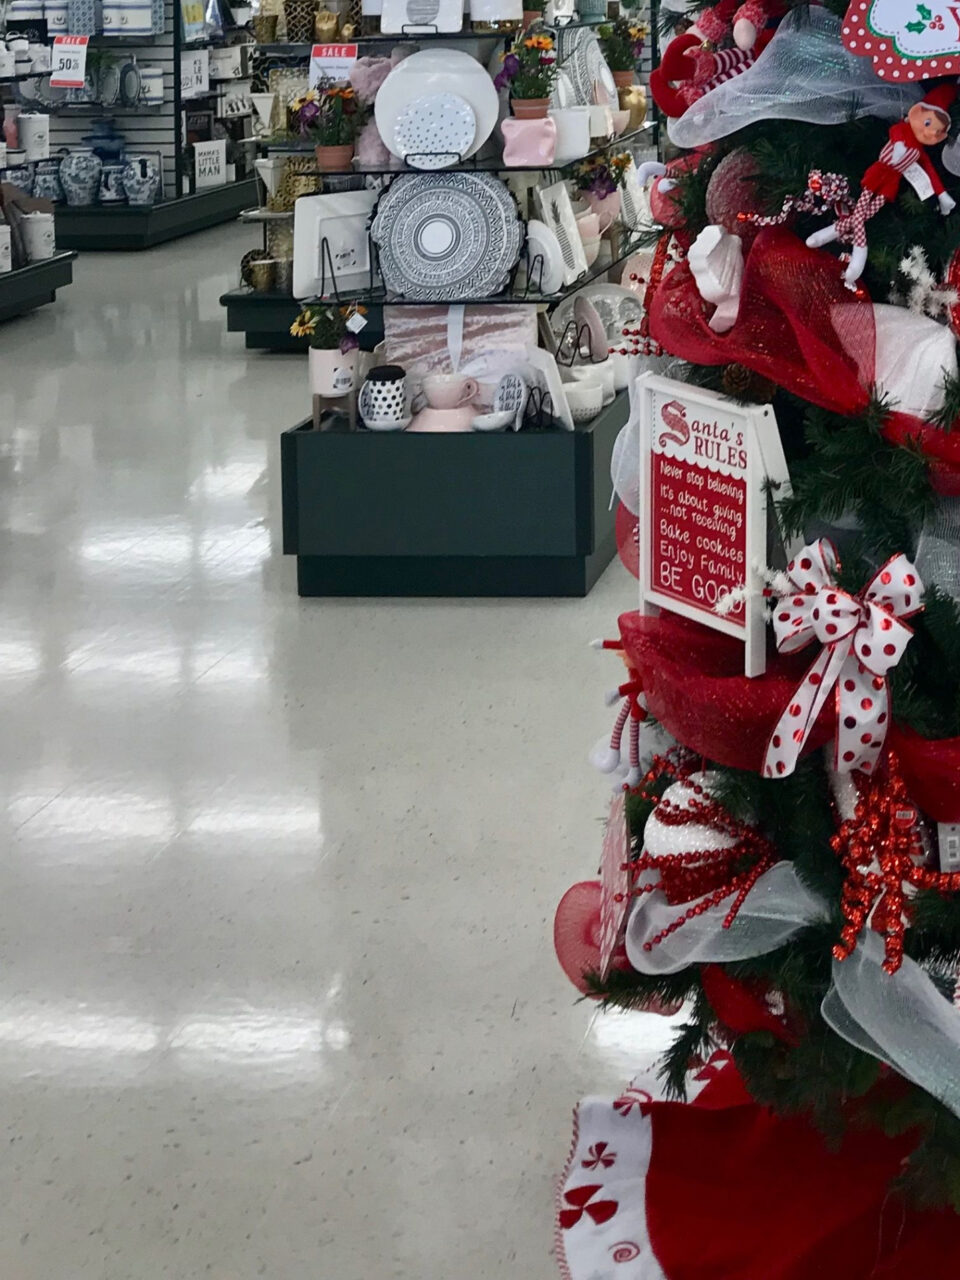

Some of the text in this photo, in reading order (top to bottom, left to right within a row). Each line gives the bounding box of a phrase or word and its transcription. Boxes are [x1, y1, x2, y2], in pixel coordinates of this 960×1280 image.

[321, 46, 348, 57] SALE
[198, 156, 220, 167] LITTLE
[198, 165, 220, 177] MAN
[658, 400, 744, 447] Santa's
[694, 435, 748, 470] RULES
[660, 460, 744, 505] Never stop believing
[660, 483, 743, 528] It's about giving
[660, 518, 744, 563] Bake cookies
[692, 511, 736, 542] receiving
[660, 540, 695, 569] Enjoy
[660, 561, 683, 592] BE
